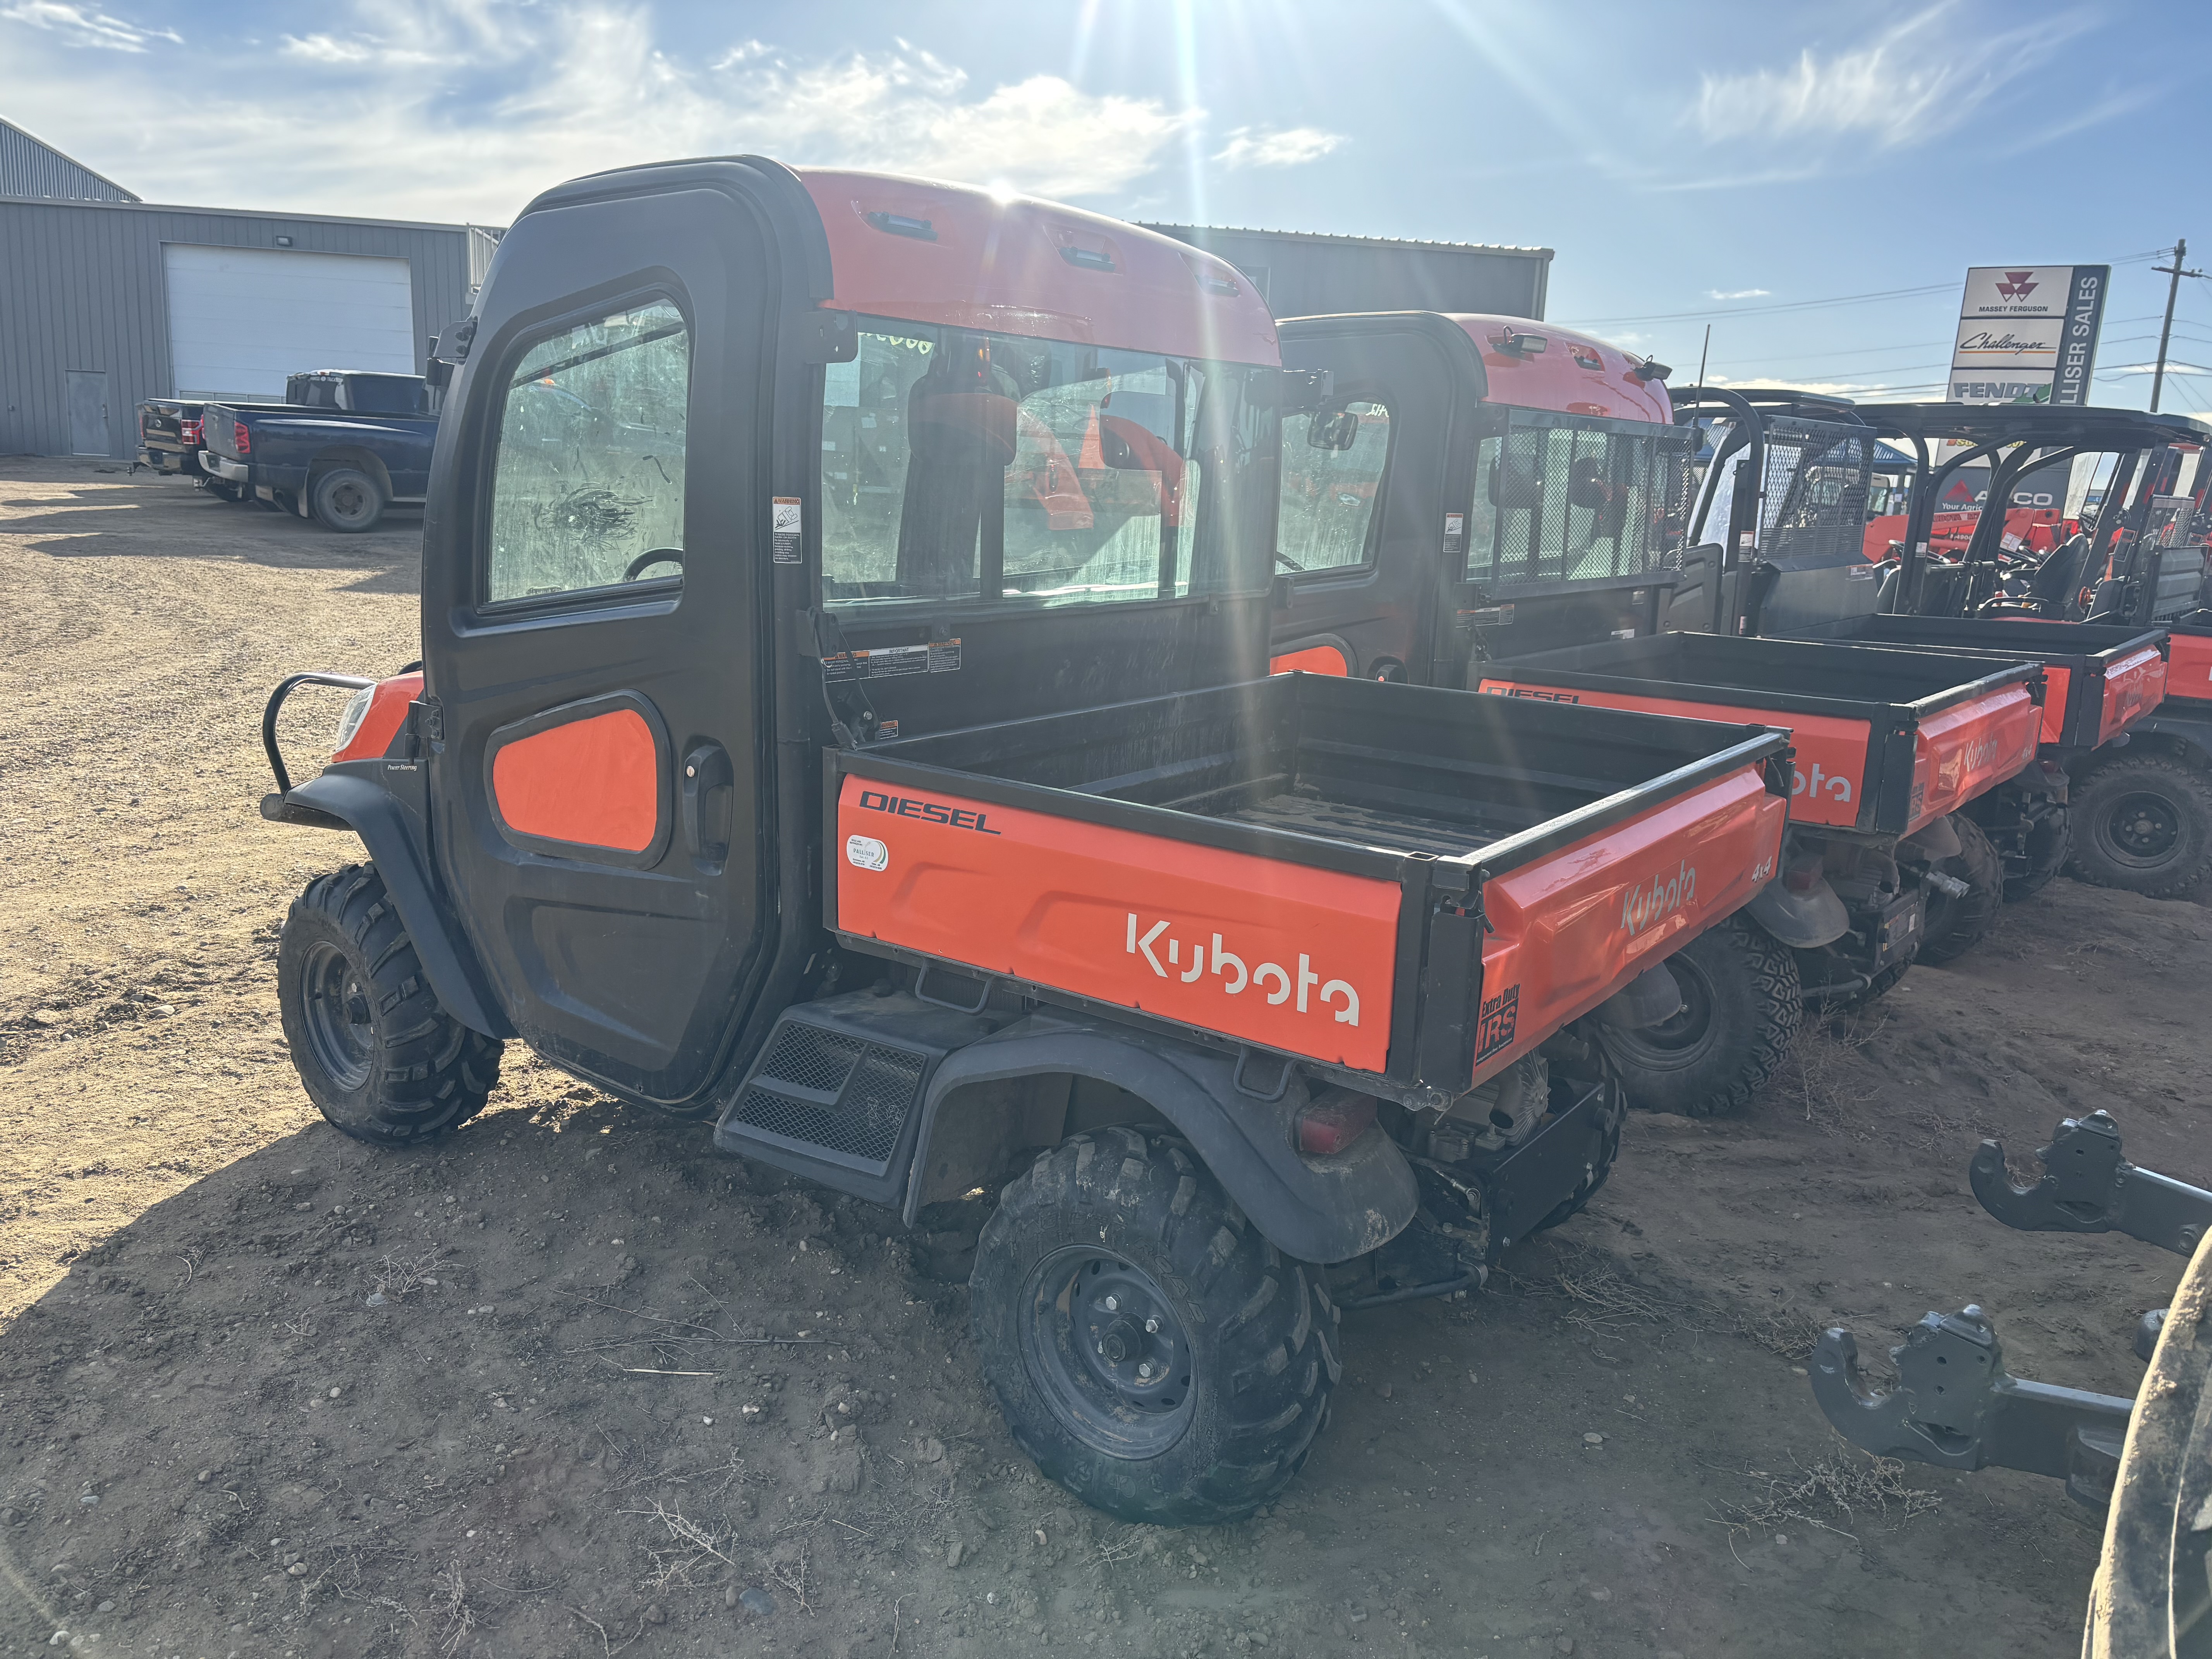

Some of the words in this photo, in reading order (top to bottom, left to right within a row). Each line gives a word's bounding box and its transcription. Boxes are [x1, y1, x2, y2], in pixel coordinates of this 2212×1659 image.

[2072, 276, 2098, 337] SALES
[1959, 332, 2057, 355] Challenger
[1953, 382, 2046, 398] FENDT
[2059, 342, 2087, 404] LLISER
[1974, 490, 2053, 506] ACO
[1791, 763, 1851, 802] ota
[859, 791, 1001, 835] DIESEL
[853, 848, 874, 857] PALLISER
[1752, 856, 1772, 883] 4x4
[1620, 859, 1695, 936] Kubota
[1126, 912, 1360, 1027] Kubota
[1482, 995, 1502, 1018] Extra
[1502, 984, 1520, 1006] Duty
[1477, 1005, 1516, 1054] IRS
